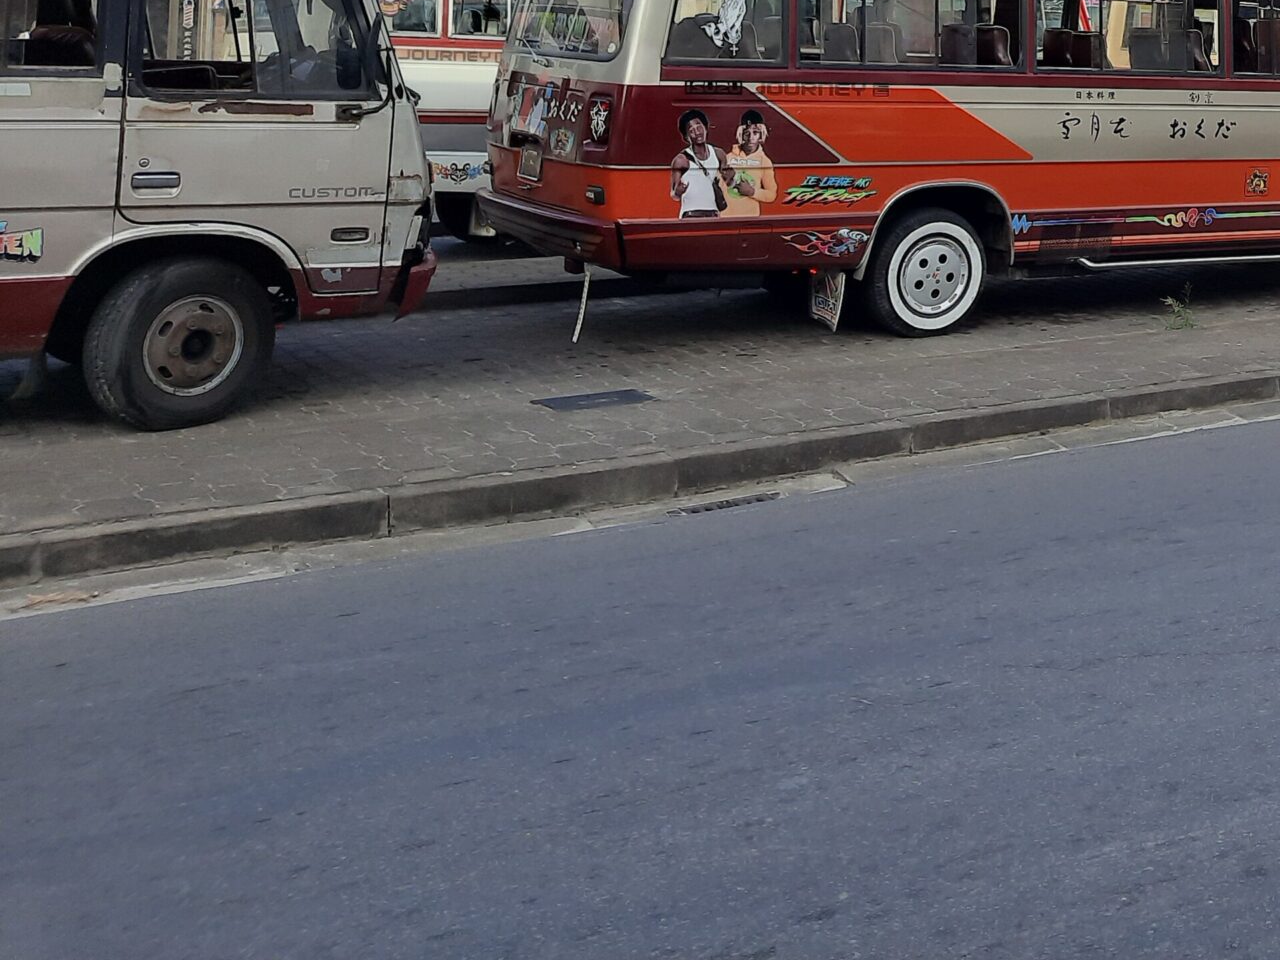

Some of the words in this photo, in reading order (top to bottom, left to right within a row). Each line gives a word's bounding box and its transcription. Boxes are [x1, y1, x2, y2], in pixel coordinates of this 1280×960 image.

[1075, 91, 1116, 100] 日本料理
[1169, 118, 1237, 139] おくだ
